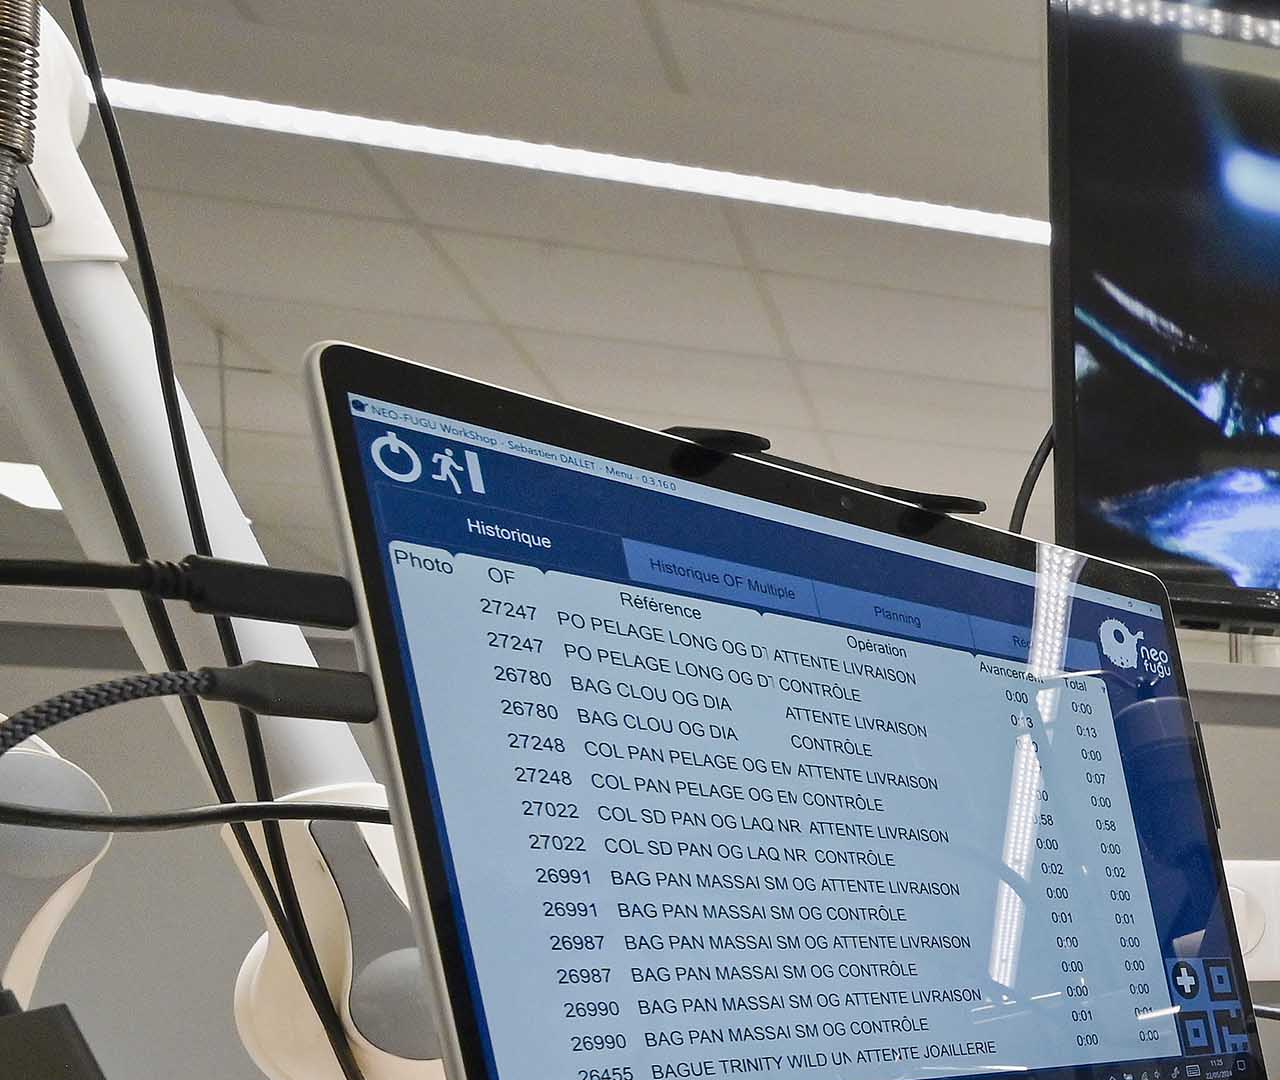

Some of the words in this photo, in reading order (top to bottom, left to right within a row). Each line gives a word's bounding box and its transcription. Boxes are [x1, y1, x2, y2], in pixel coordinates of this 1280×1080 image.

[371, 404, 437, 431] NEO-FUGU
[440, 424, 497, 447] WorkShop
[560, 453, 596, 471] DALLET
[605, 465, 633, 481] Menu
[467, 518, 552, 549] Historique
[650, 558, 720, 585] Historique
[724, 573, 744, 588] OF
[748, 578, 796, 600] Multiple
[394, 549, 454, 575] Photo
[487, 567, 516, 585] OF
[619, 592, 702, 620] Référence
[846, 635, 907, 659] Opération
[1064, 677, 1087, 692] Total
[874, 606, 921, 628] Planning
[480, 598, 537, 621] 27247
[557, 611, 586, 629] PO
[590, 616, 665, 643] PELAGE
[668, 630, 718, 652] LONG
[722, 640, 747, 656] OG
[774, 649, 840, 672] ATTENTE
[842, 660, 916, 685] LIVRAISON
[1140, 645, 1170, 665] neo
[487, 632, 543, 654] 27247
[564, 643, 592, 661] PO
[597, 648, 671, 674] PELAGE
[675, 660, 724, 681] LONG
[728, 669, 753, 686] OG
[778, 677, 862, 702] CONTRÔLE
[1076, 725, 1097, 738] 0:13
[1143, 659, 1172, 679] fugu
[494, 665, 552, 687] 26780
[570, 676, 612, 695] BAG
[616, 682, 667, 703] CLOU
[672, 690, 699, 707] OG
[703, 694, 732, 712] DIA
[785, 706, 852, 728] ATTENTE
[854, 716, 928, 738] LIVRAISON
[500, 699, 558, 720] 26780
[576, 708, 618, 727] BAG
[623, 714, 673, 734] CLOU
[678, 720, 705, 738] OG
[709, 724, 739, 741] DIA
[790, 734, 873, 757] CONTRÔLE
[507, 733, 566, 753] 27248
[584, 740, 625, 759] COL
[627, 745, 665, 763] PAN
[668, 750, 739, 770] PELAGE
[742, 757, 768, 774] OG
[797, 764, 864, 783] ATTENTE
[866, 770, 938, 790] LIVRAISON
[514, 766, 572, 786] 27248
[591, 773, 631, 791] COL
[634, 777, 672, 794] PAN
[675, 780, 745, 800] PELAGE
[748, 787, 774, 802] OG
[802, 792, 885, 812] CONTRÔLE
[521, 800, 580, 819] 27022
[598, 805, 638, 823] COL
[640, 808, 666, 824] SD
[671, 811, 707, 827] PAN
[710, 813, 737, 829] OG
[740, 816, 775, 832] LAQ
[777, 818, 802, 833] NR
[809, 821, 875, 838] ATTENTE
[877, 826, 949, 843] LIVRAISON
[528, 834, 586, 852] 27022
[604, 838, 645, 854] COL
[647, 840, 673, 856] SD
[677, 842, 713, 858] PAN
[717, 844, 744, 860] OG
[746, 846, 781, 862] LAQ
[783, 848, 808, 862] NR
[814, 849, 896, 867] CONTRÔLE
[535, 868, 591, 884] 26991
[610, 870, 651, 886] BAG
[655, 872, 692, 888] PAN
[696, 874, 760, 890] MASSAI
[764, 876, 789, 890] SM
[792, 877, 816, 892] OG
[821, 878, 886, 894] ATTENTE
[888, 880, 960, 896] LIVRAISON
[542, 901, 598, 917] 26991
[617, 902, 658, 918] BAG
[662, 904, 699, 918] PAN
[702, 904, 766, 920] MASSAI
[770, 905, 795, 920] SM
[798, 906, 822, 920] OG
[826, 904, 907, 922] CONTRÔLE
[549, 935, 604, 950] 26987
[624, 934, 664, 950] BAG
[668, 935, 705, 950] PAN
[708, 935, 773, 950] MASSAI
[776, 935, 801, 950] SM
[804, 935, 828, 950] OG
[833, 936, 898, 949] ATTENTE
[900, 936, 971, 949] LIVRAISON
[556, 968, 611, 984] 26987
[631, 966, 671, 982] BAG
[675, 966, 711, 981] PAN
[715, 965, 779, 980] MASSAI
[782, 964, 807, 979] SM
[810, 964, 834, 979] OG
[838, 960, 918, 978] CONTRÔLE
[564, 1001, 620, 1018] 26990
[637, 998, 678, 1015] BAG
[681, 997, 718, 1013] PAN
[721, 995, 785, 1012] MASSAI
[788, 994, 813, 1009] SM
[816, 993, 840, 1008] OG
[845, 991, 909, 1006] ATTENTE
[911, 988, 982, 1004] LIVRAISON
[570, 1034, 626, 1052] 26990
[644, 1030, 684, 1047] BAG
[688, 1028, 724, 1045] PAN
[728, 1025, 792, 1042] MASSAI
[795, 1024, 819, 1038] SM
[822, 1022, 846, 1037] OG
[850, 1015, 930, 1035] CONTRÔLE
[651, 1060, 716, 1080] BAGUE
[718, 1056, 783, 1074] TRINITY
[786, 1053, 828, 1069] WILD
[856, 1046, 920, 1064] ATTENTE
[923, 1040, 997, 1059] JOAILLERIE
